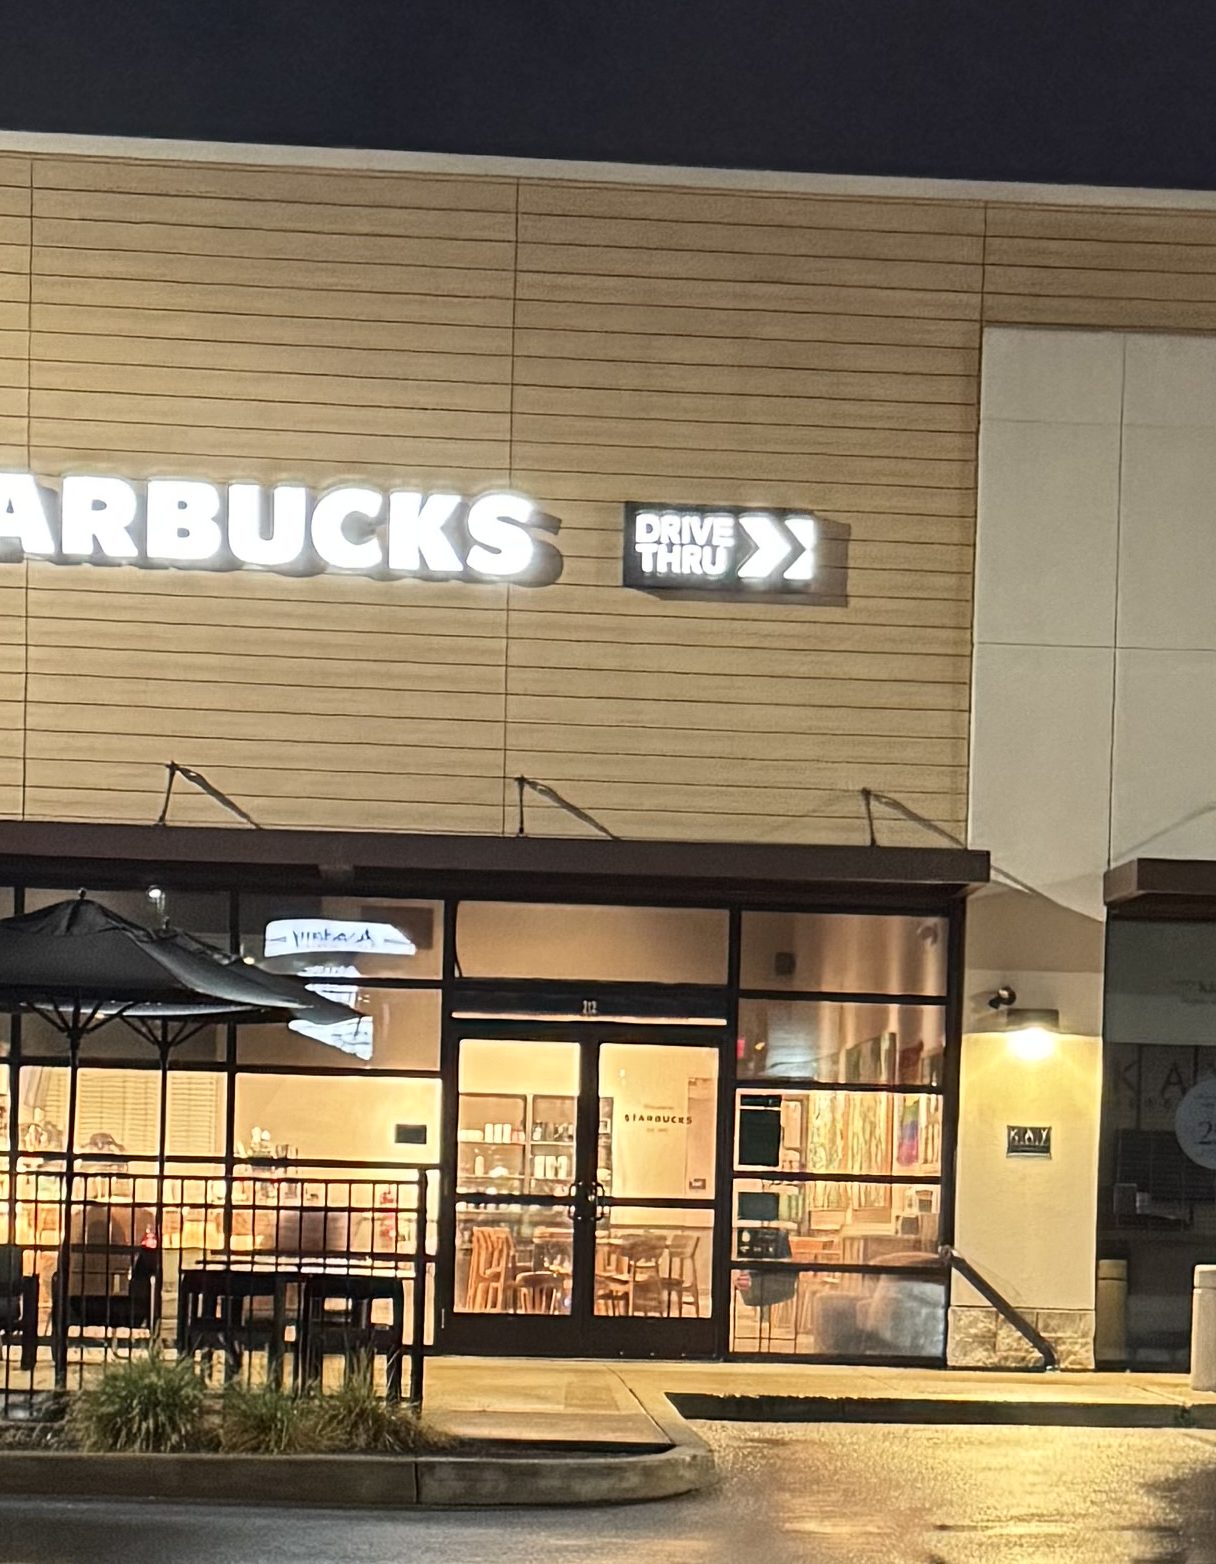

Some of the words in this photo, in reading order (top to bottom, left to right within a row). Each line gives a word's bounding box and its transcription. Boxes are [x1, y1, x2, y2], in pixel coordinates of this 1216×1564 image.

[634, 511, 735, 547] DRIVE
[634, 542, 728, 577] THRU
[624, 1113, 693, 1125] STARBUCKS
